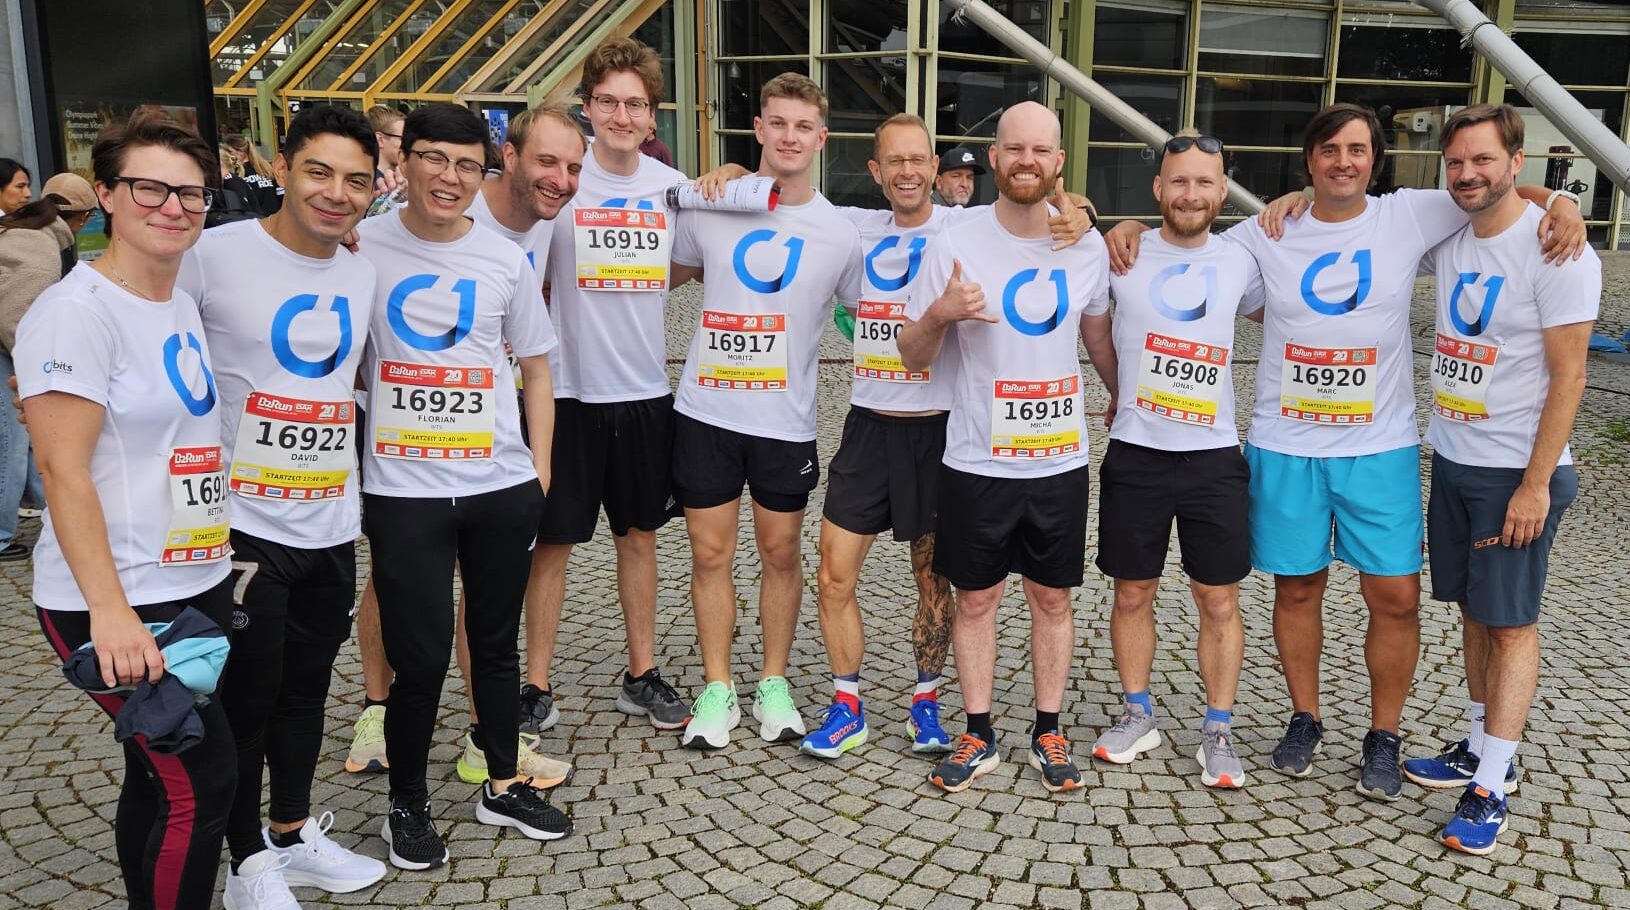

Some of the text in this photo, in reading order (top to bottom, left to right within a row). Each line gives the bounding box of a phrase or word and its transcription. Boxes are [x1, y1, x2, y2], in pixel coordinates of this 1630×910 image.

[588, 229, 659, 250] 16919
[708, 331, 776, 353] 16917
[53, 359, 73, 372] bits
[1150, 355, 1218, 386] 16908
[1292, 364, 1367, 387] 16920
[1434, 354, 1483, 385] 16910
[1172, 381, 1194, 391] JONAS
[1444, 380, 1457, 388] ALEX
[391, 386, 483, 414] 16923
[1005, 397, 1073, 421] 16918
[418, 414, 456, 423] FLORIAN
[1030, 421, 1052, 429] MICHA
[255, 421, 347, 451] 16922
[291, 453, 319, 462] DAVID
[265, 472, 302, 481] STARTZEIT
[1474, 536, 1503, 549] SCO
[232, 560, 258, 605] 7
[828, 719, 858, 745] BROOKS
